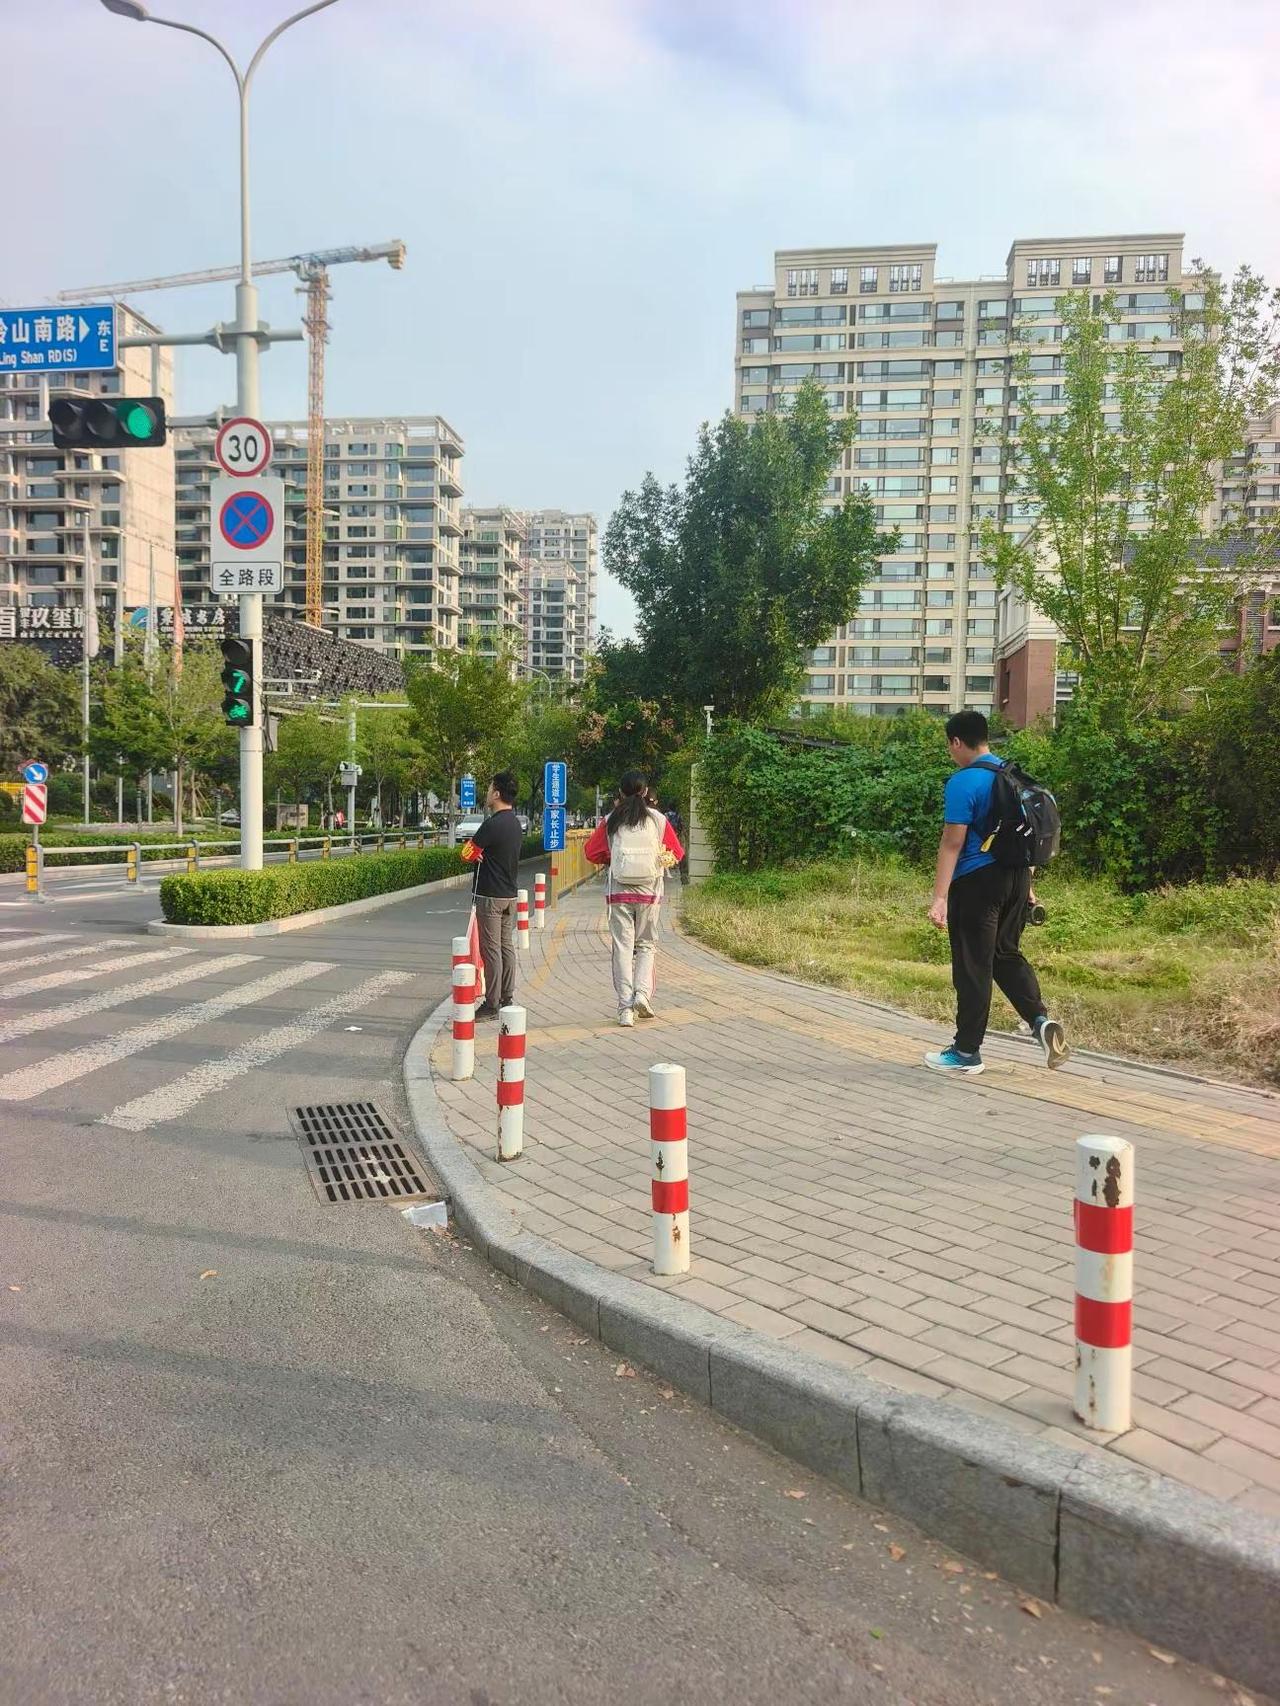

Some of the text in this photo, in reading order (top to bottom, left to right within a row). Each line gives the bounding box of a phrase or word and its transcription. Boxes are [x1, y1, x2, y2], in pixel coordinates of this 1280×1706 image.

[97, 320, 111, 336] 东
[100, 339, 109, 352] E
[21, 350, 44, 364] Shan
[48, 348, 77, 363] RD(S)
[228, 435, 258, 462] 30
[219, 568, 274, 587] 全路段
[232, 672, 245, 693] 7
[550, 809, 560, 848] 家长止步
